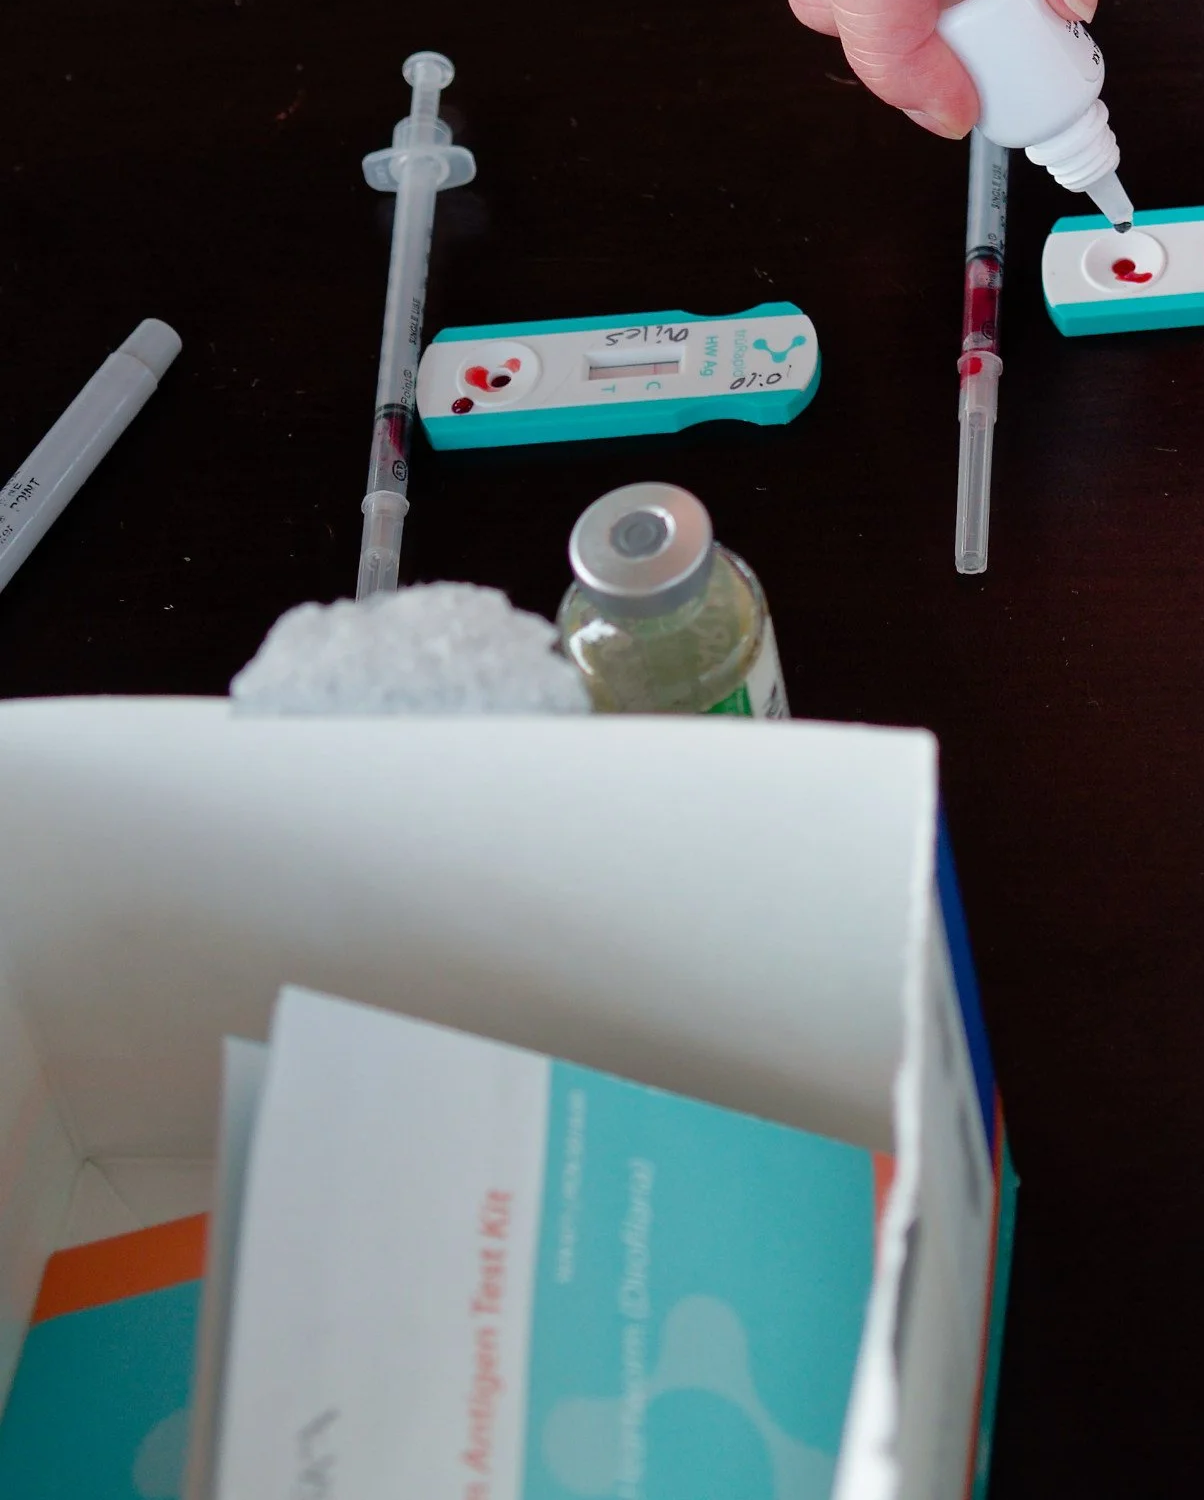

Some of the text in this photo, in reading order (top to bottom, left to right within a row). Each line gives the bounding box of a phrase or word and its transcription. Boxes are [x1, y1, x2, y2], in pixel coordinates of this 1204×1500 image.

[699, 335, 719, 377] HW Ag
[601, 384, 616, 394] T
[645, 381, 661, 391] C
[9, 477, 40, 513] POINT
[480, 1189, 514, 1240] Kit
[470, 1247, 507, 1316] Test
[461, 1325, 507, 1474] Antigen
